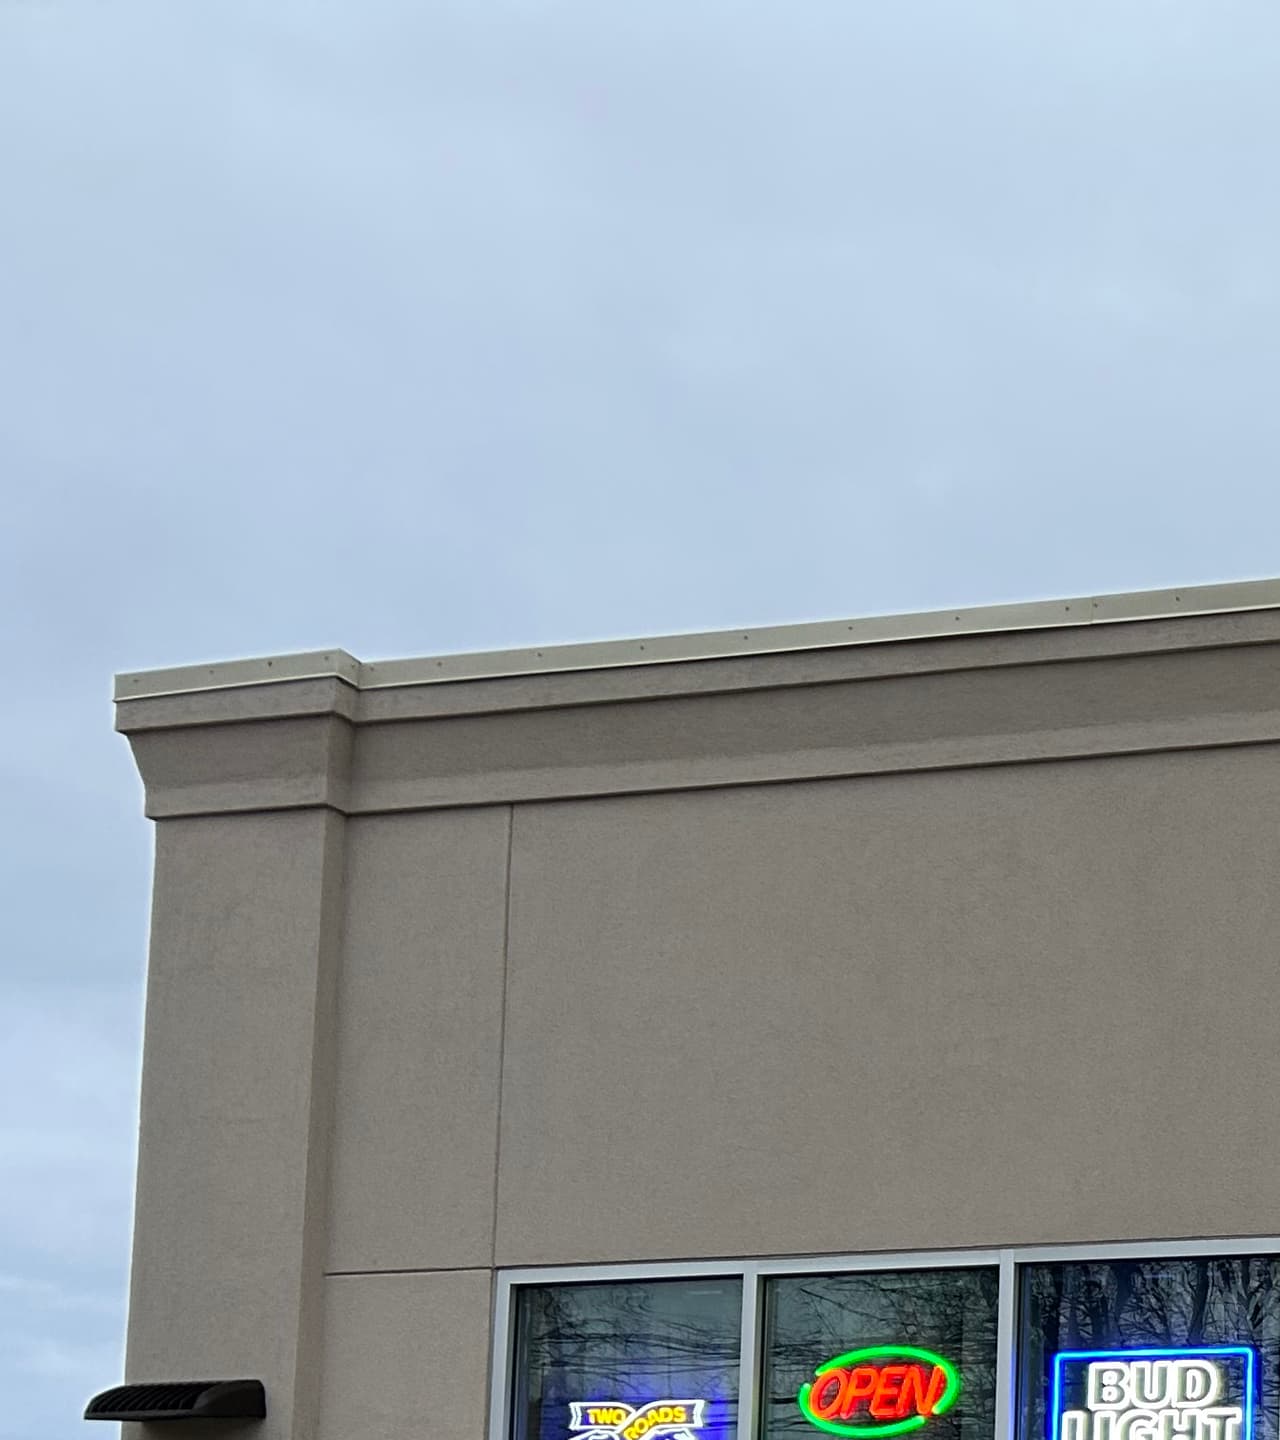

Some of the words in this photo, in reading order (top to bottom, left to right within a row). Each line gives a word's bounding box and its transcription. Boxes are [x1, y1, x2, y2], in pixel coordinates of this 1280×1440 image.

[809, 1363, 946, 1420] OPEN
[1088, 1359, 1218, 1412] BUD
[587, 1408, 628, 1426] TWO
